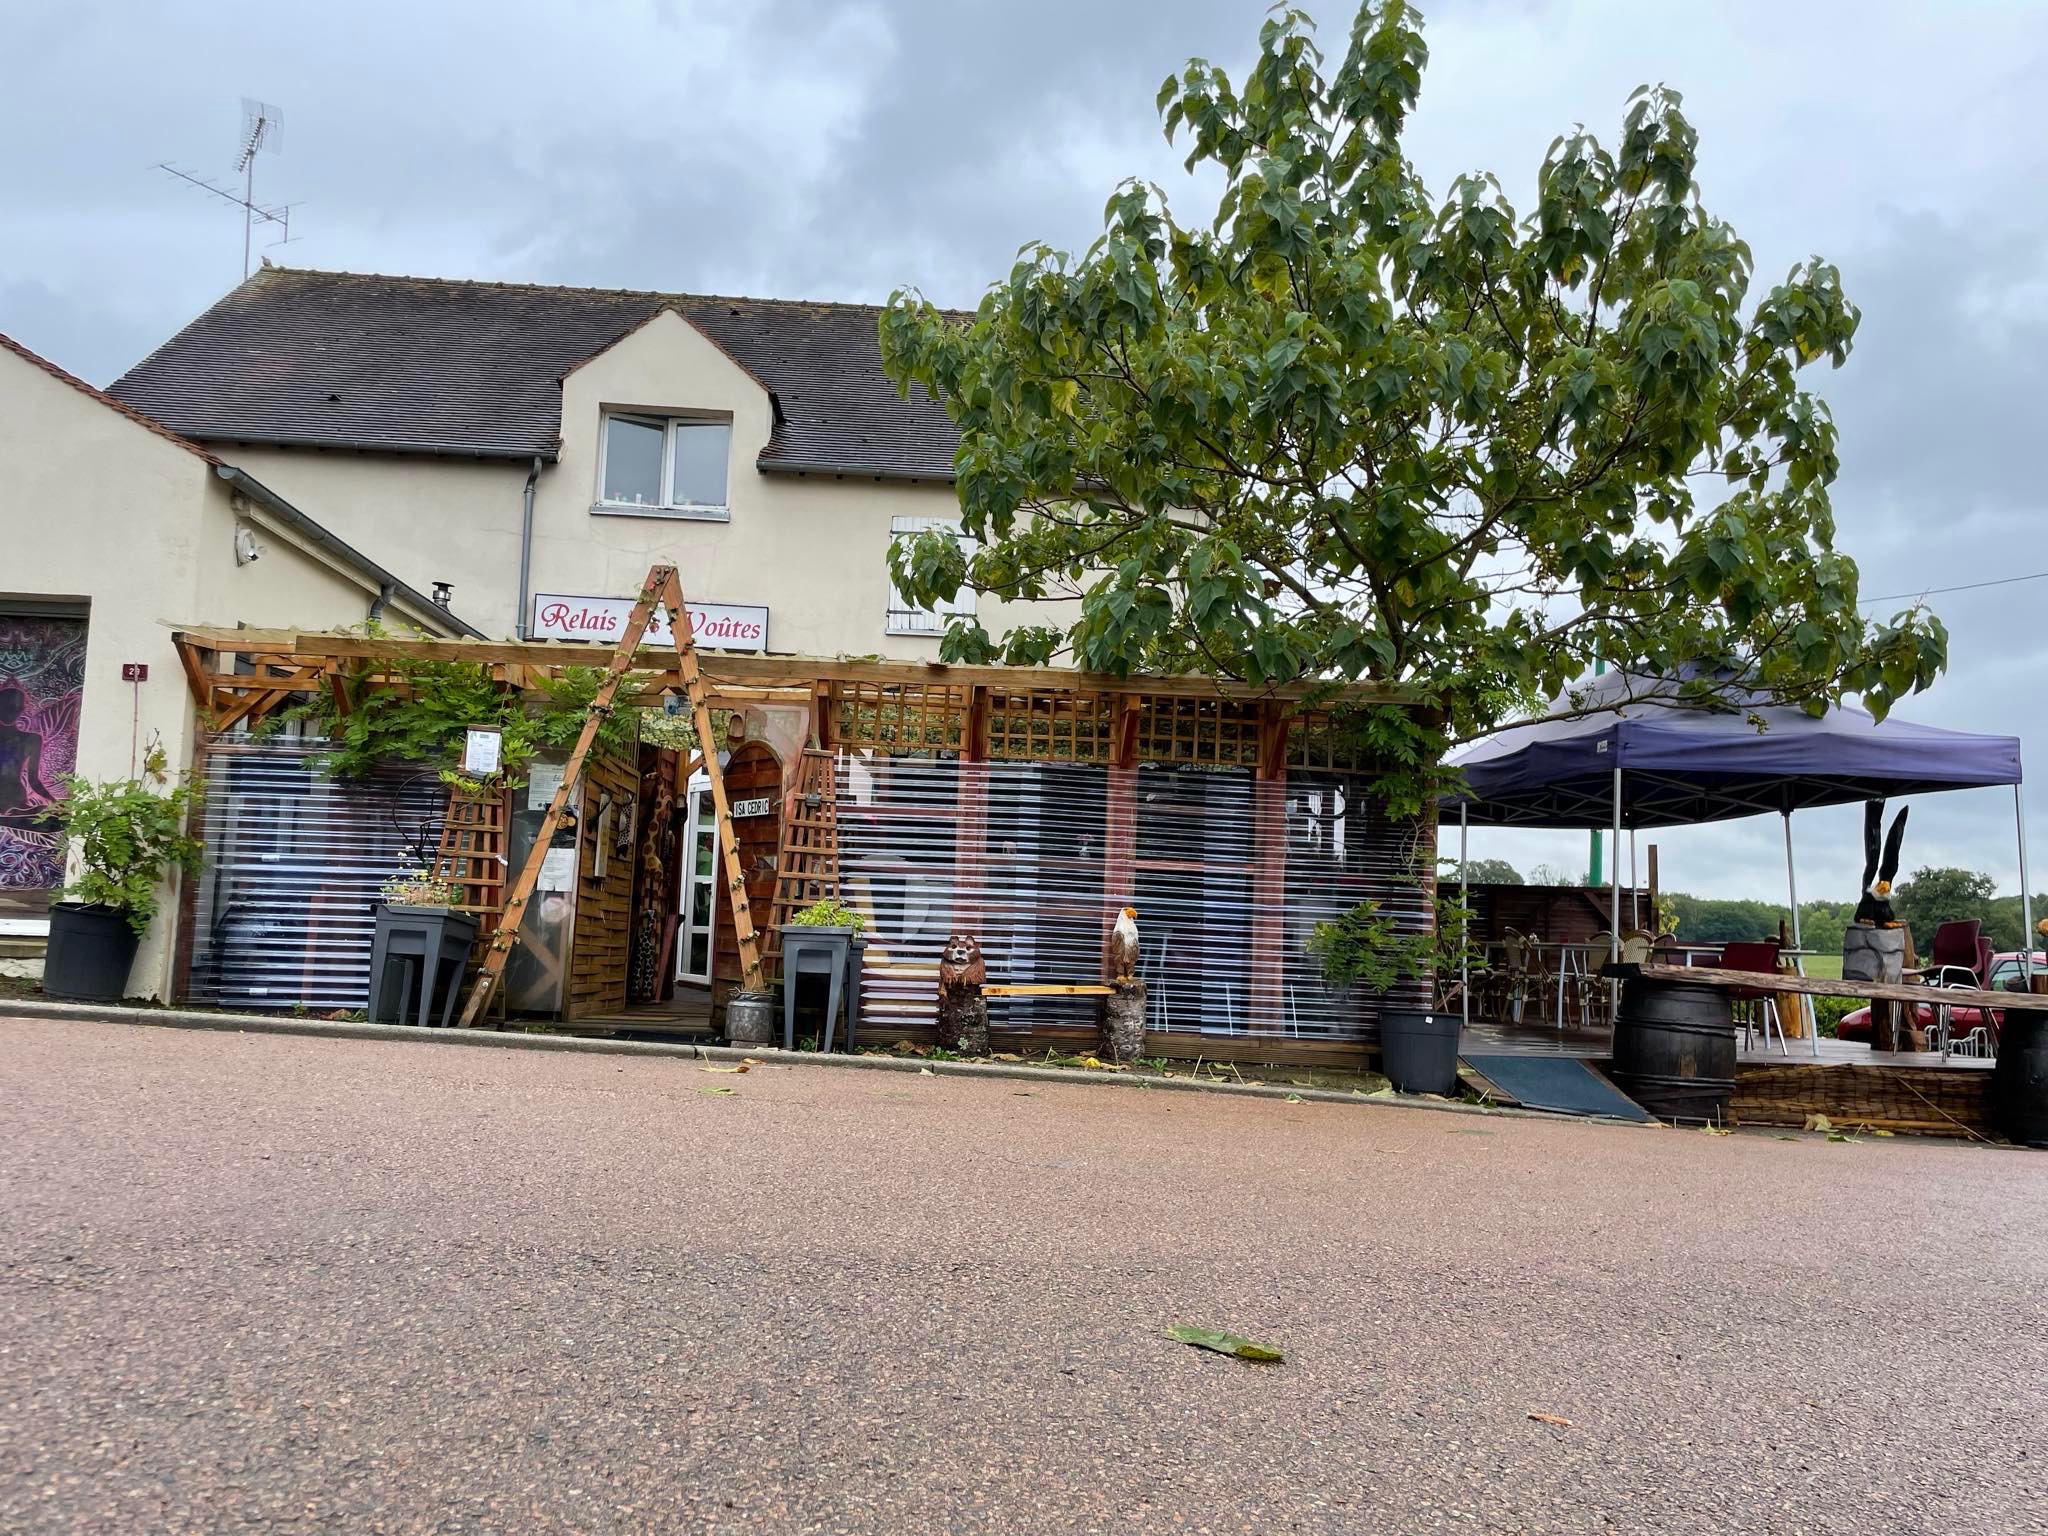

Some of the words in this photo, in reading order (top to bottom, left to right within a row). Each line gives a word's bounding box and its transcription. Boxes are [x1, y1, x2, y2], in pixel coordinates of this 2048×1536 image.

[541, 603, 617, 632] Relais
[686, 611, 761, 639] Voûtes
[735, 802, 746, 816] ISA
[747, 800, 768, 815] CEDRIC
